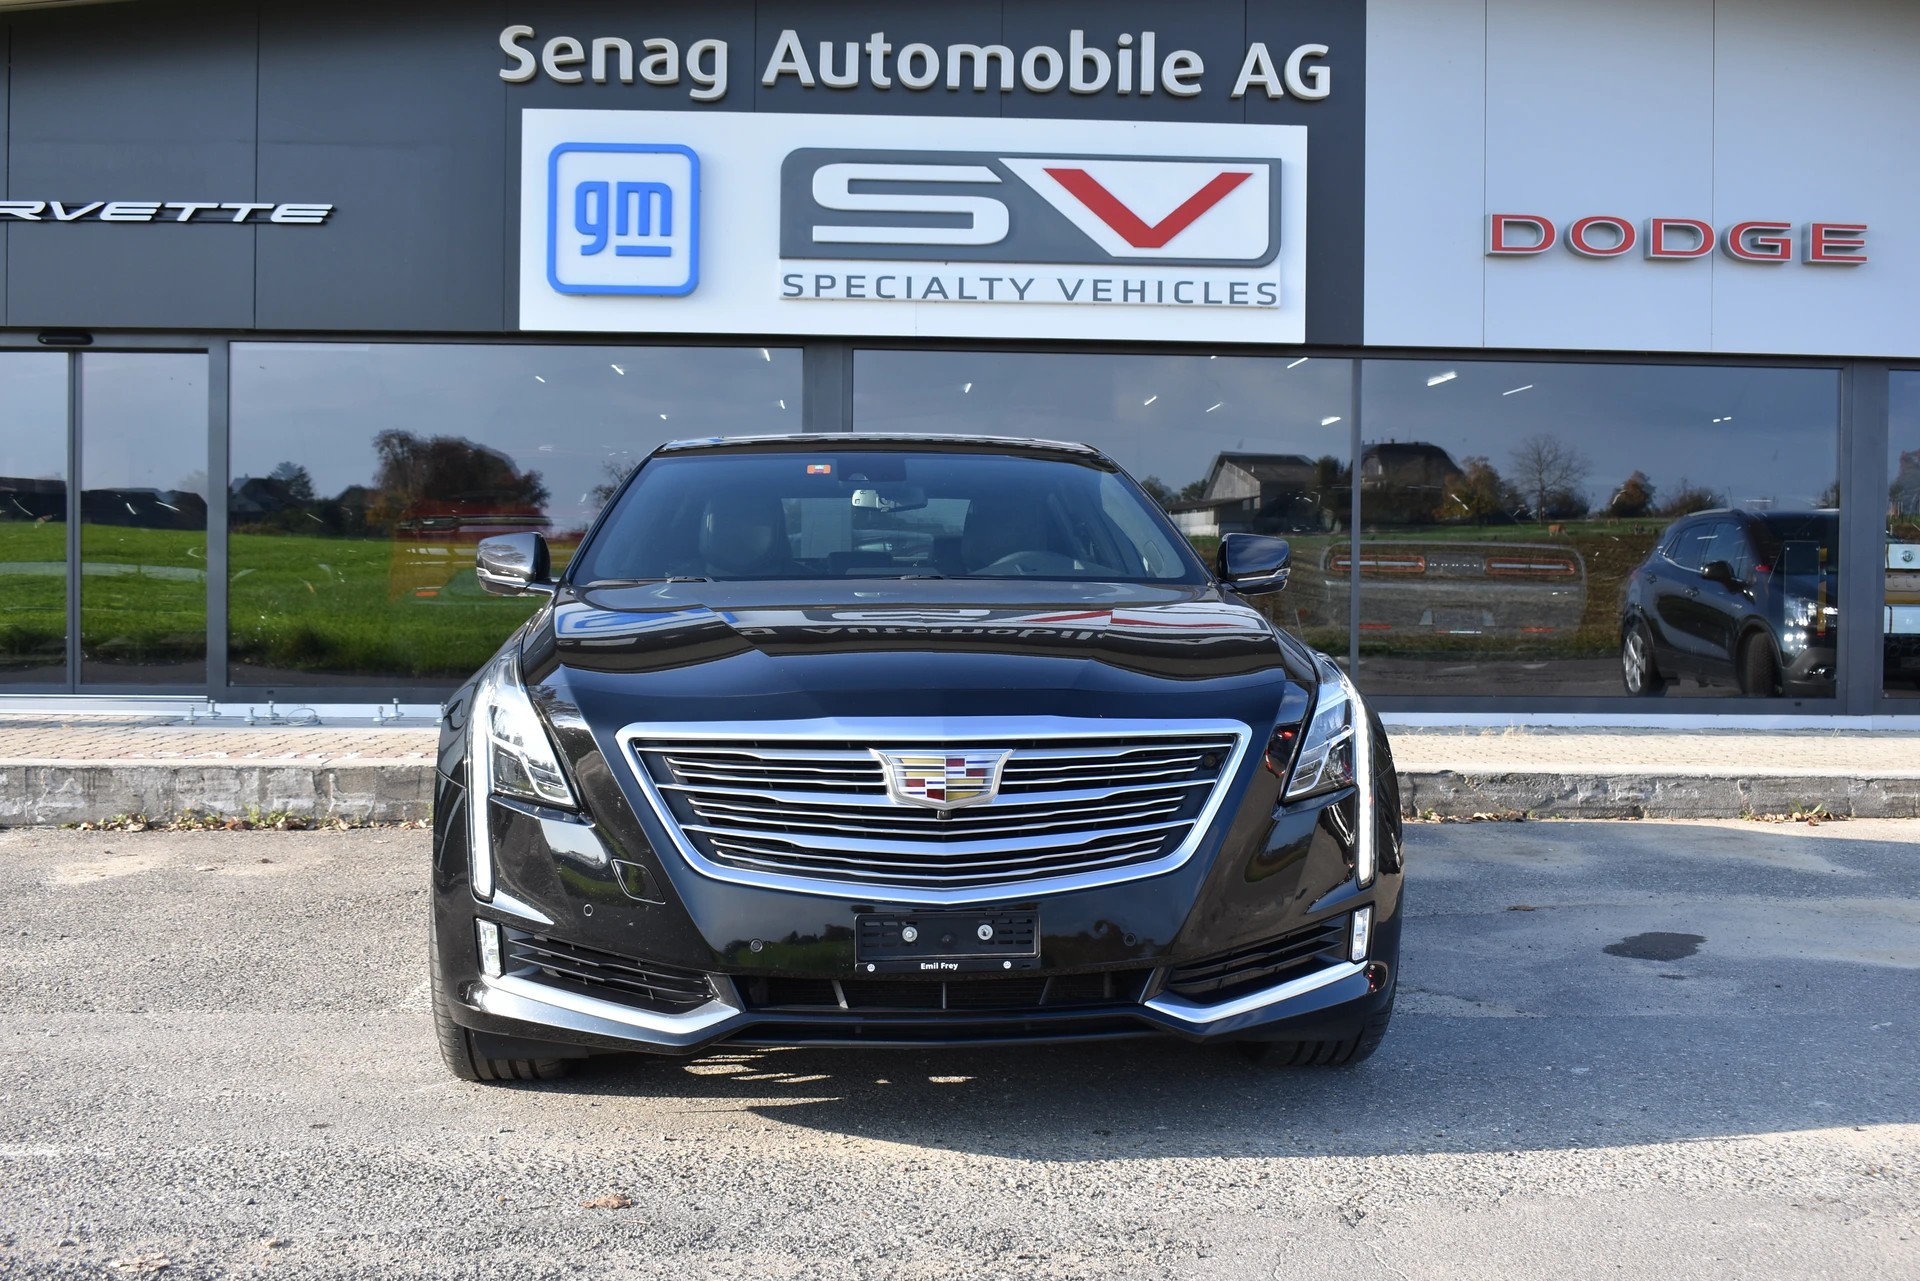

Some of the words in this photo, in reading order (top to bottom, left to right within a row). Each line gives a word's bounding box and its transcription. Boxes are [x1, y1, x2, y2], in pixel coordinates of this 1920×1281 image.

[498, 25, 729, 102] Senag
[761, 28, 1205, 98] Automobile
[1230, 41, 1332, 100] AG
[574, 180, 673, 256] gm
[1485, 212, 1868, 265] DODGE
[782, 272, 1037, 303] SPECIALTY
[1056, 277, 1279, 306] VEHICLES
[920, 962, 939, 970] Emil
[940, 962, 959, 971] Frey
